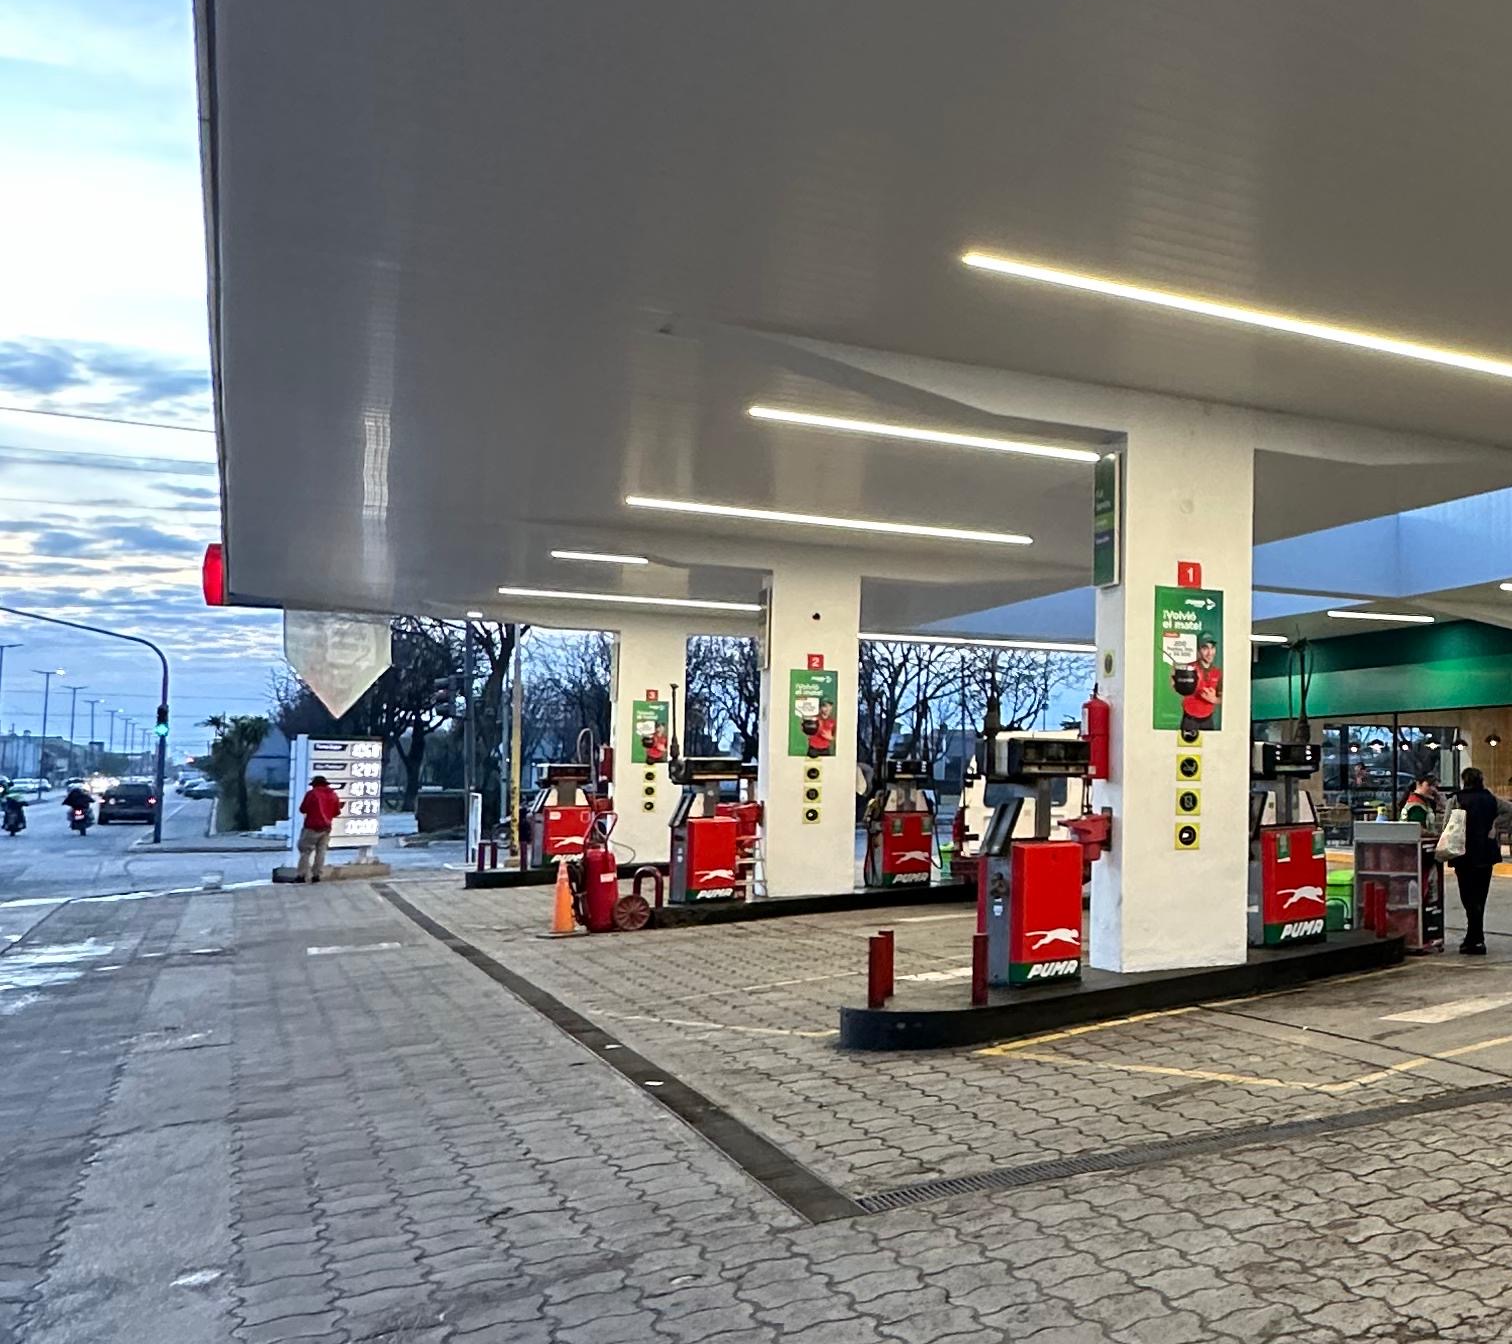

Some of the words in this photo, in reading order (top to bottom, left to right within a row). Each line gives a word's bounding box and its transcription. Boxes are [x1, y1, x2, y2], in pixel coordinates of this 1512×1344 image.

[1186, 567, 1194, 583] 1
[811, 657, 820, 668] 2
[892, 872, 929, 884] PUMA
[696, 887, 733, 899] PUMA
[1280, 918, 1325, 940] PUMA
[1027, 959, 1079, 979] PUMA
